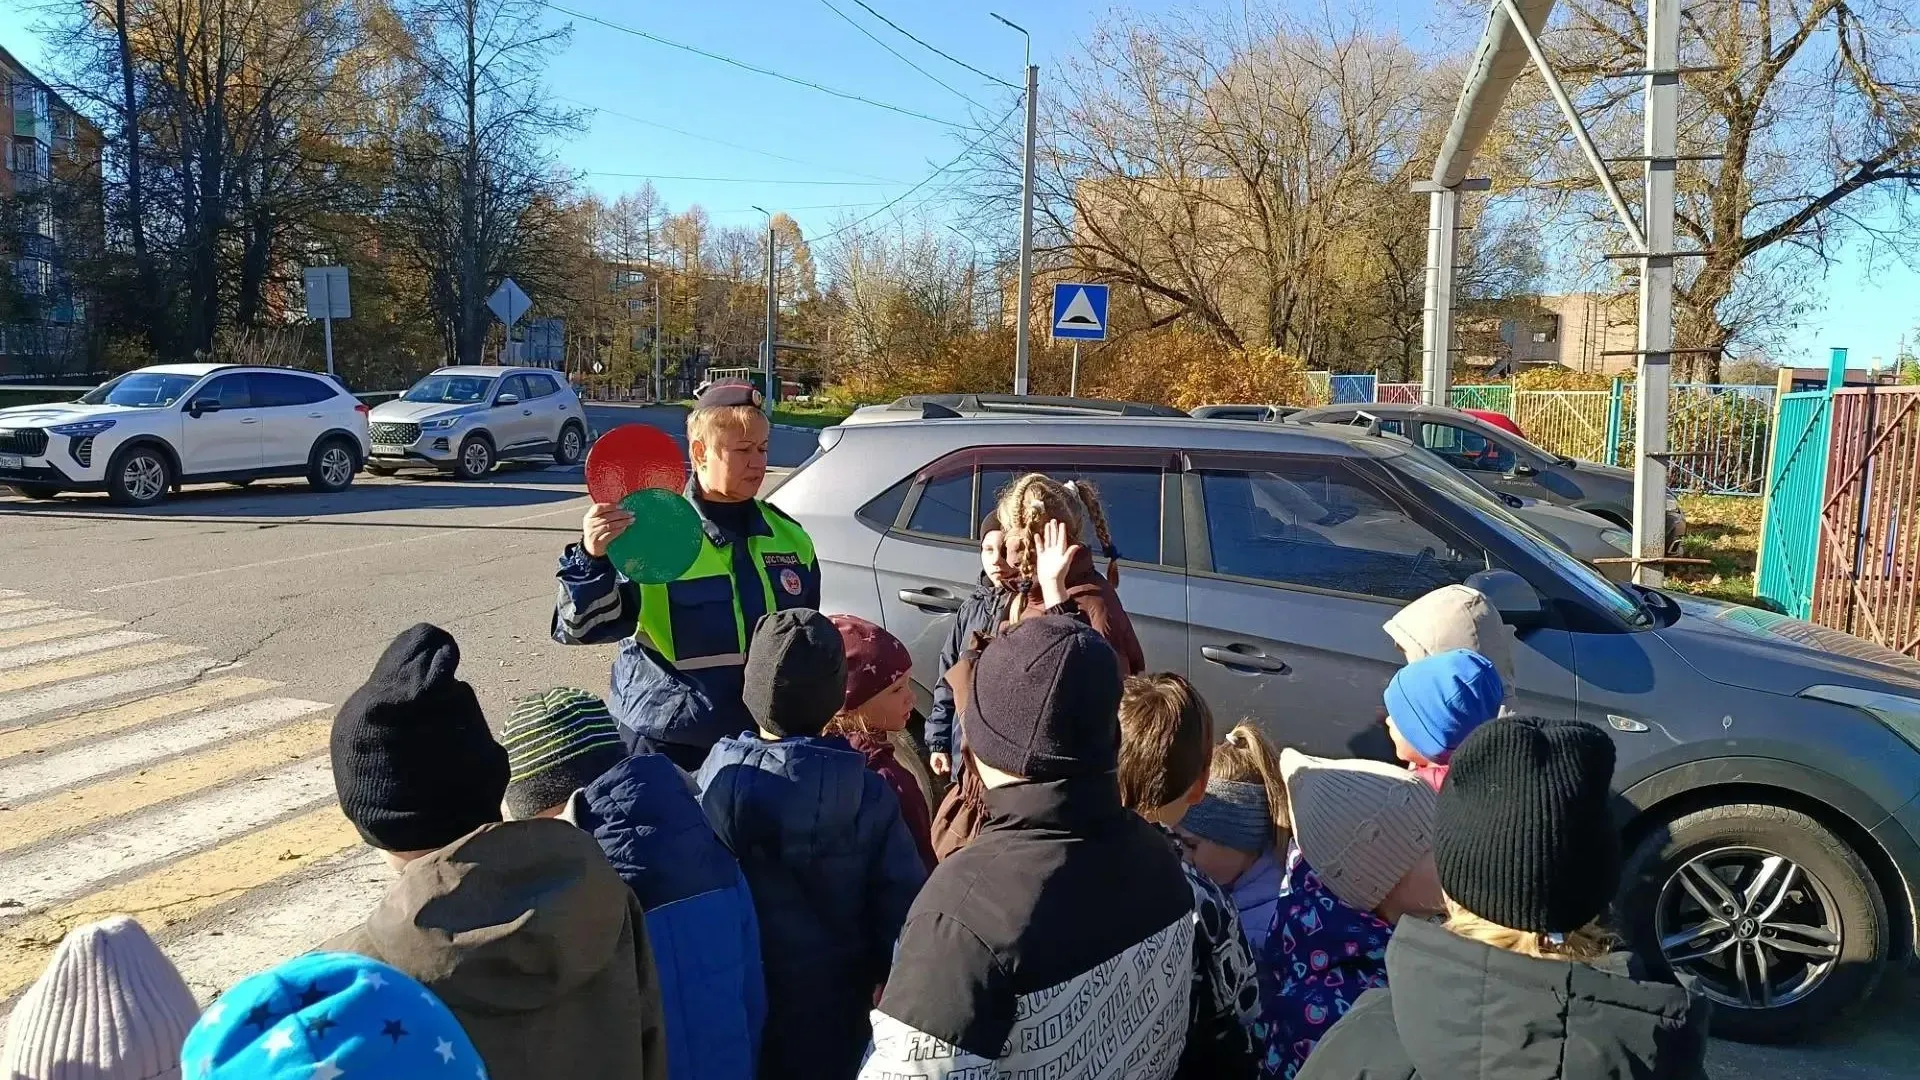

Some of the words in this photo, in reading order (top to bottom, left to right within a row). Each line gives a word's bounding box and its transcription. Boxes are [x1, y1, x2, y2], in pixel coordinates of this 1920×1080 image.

[1021, 979, 1093, 1054] RIDERS
[1098, 972, 1132, 1037] RIDE
[1117, 978, 1160, 1045] CLUB
